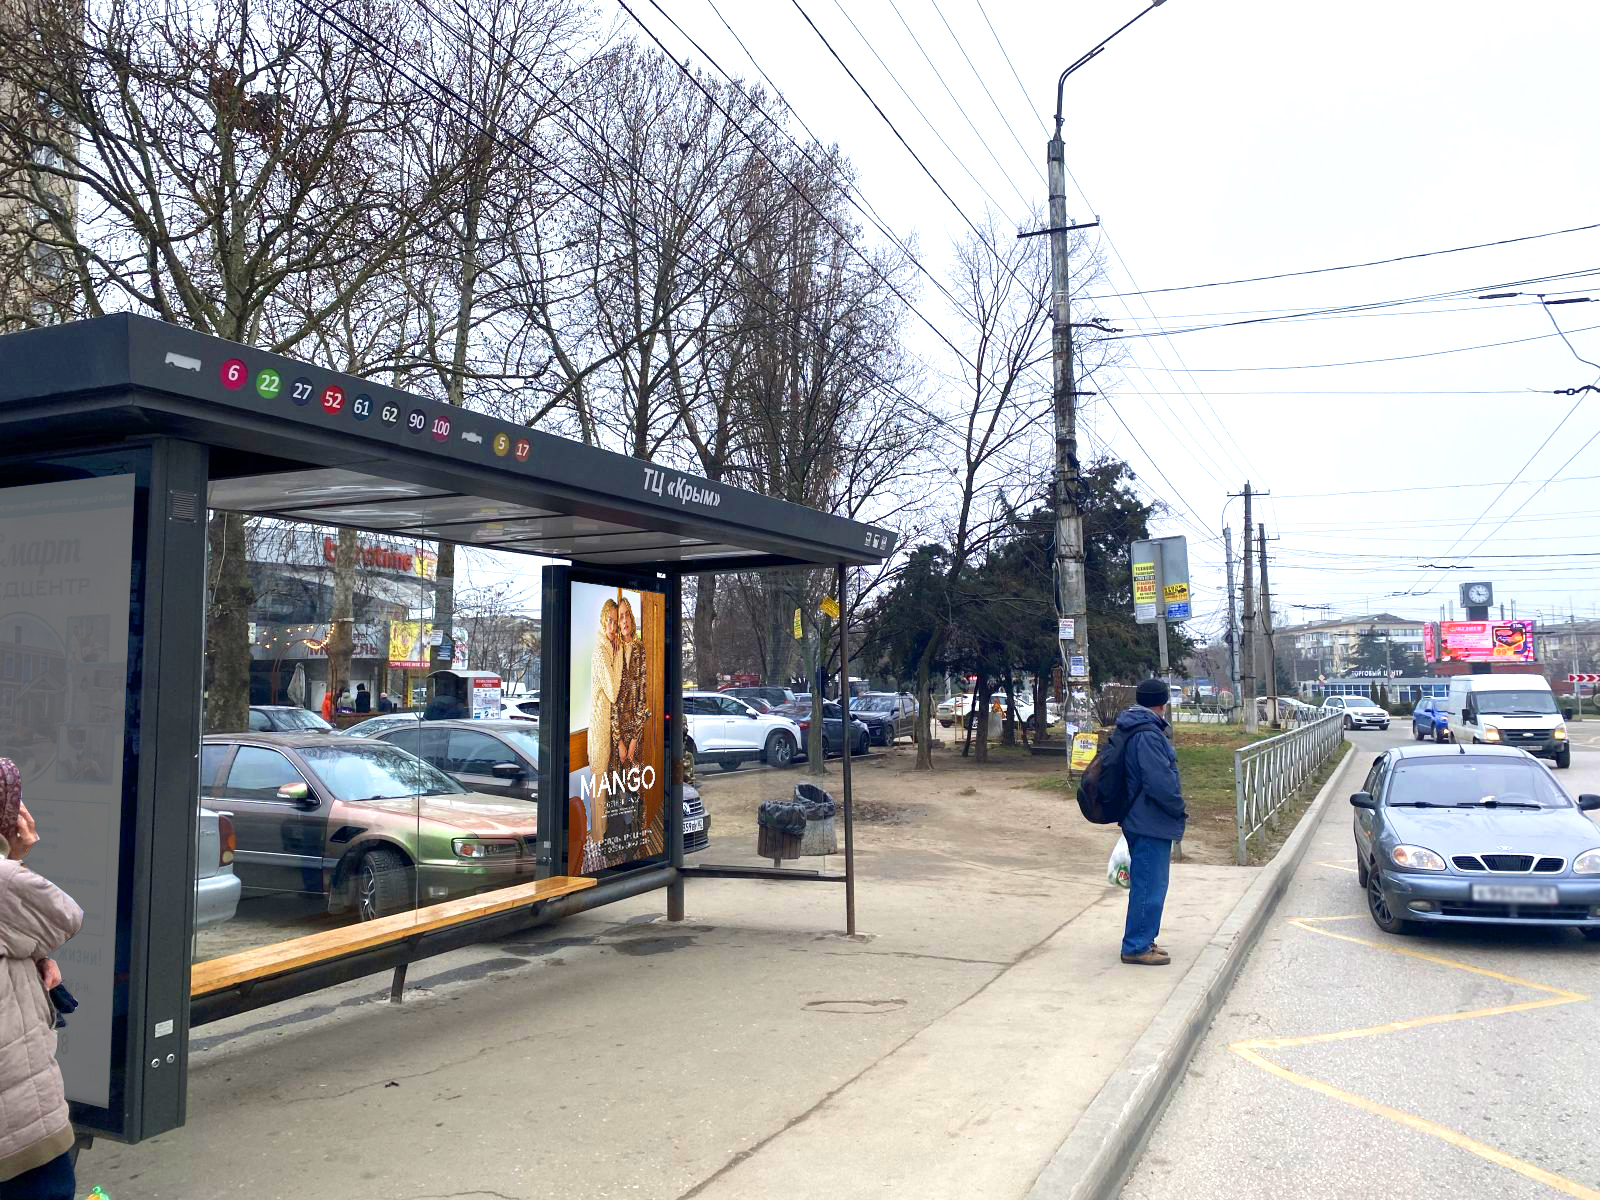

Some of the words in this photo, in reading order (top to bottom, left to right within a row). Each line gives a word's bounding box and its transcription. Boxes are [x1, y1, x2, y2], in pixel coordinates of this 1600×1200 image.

[228, 364, 240, 381] 6
[261, 374, 280, 392] 22
[292, 382, 313, 400] 27
[324, 391, 342, 409] 52
[353, 399, 369, 416] 61
[382, 406, 398, 423] 62
[409, 413, 425, 430] 90
[432, 420, 450, 436] 100
[497, 437, 506, 450] 5
[516, 443, 530, 457] 17
[644, 467, 664, 496] ТЦ
[667, 476, 721, 507] «Крым»
[0, 577, 90, 600] ДЦЕНТР
[1383, 669, 1403, 678] ЦНТР
[580, 765, 656, 801] MANGO
